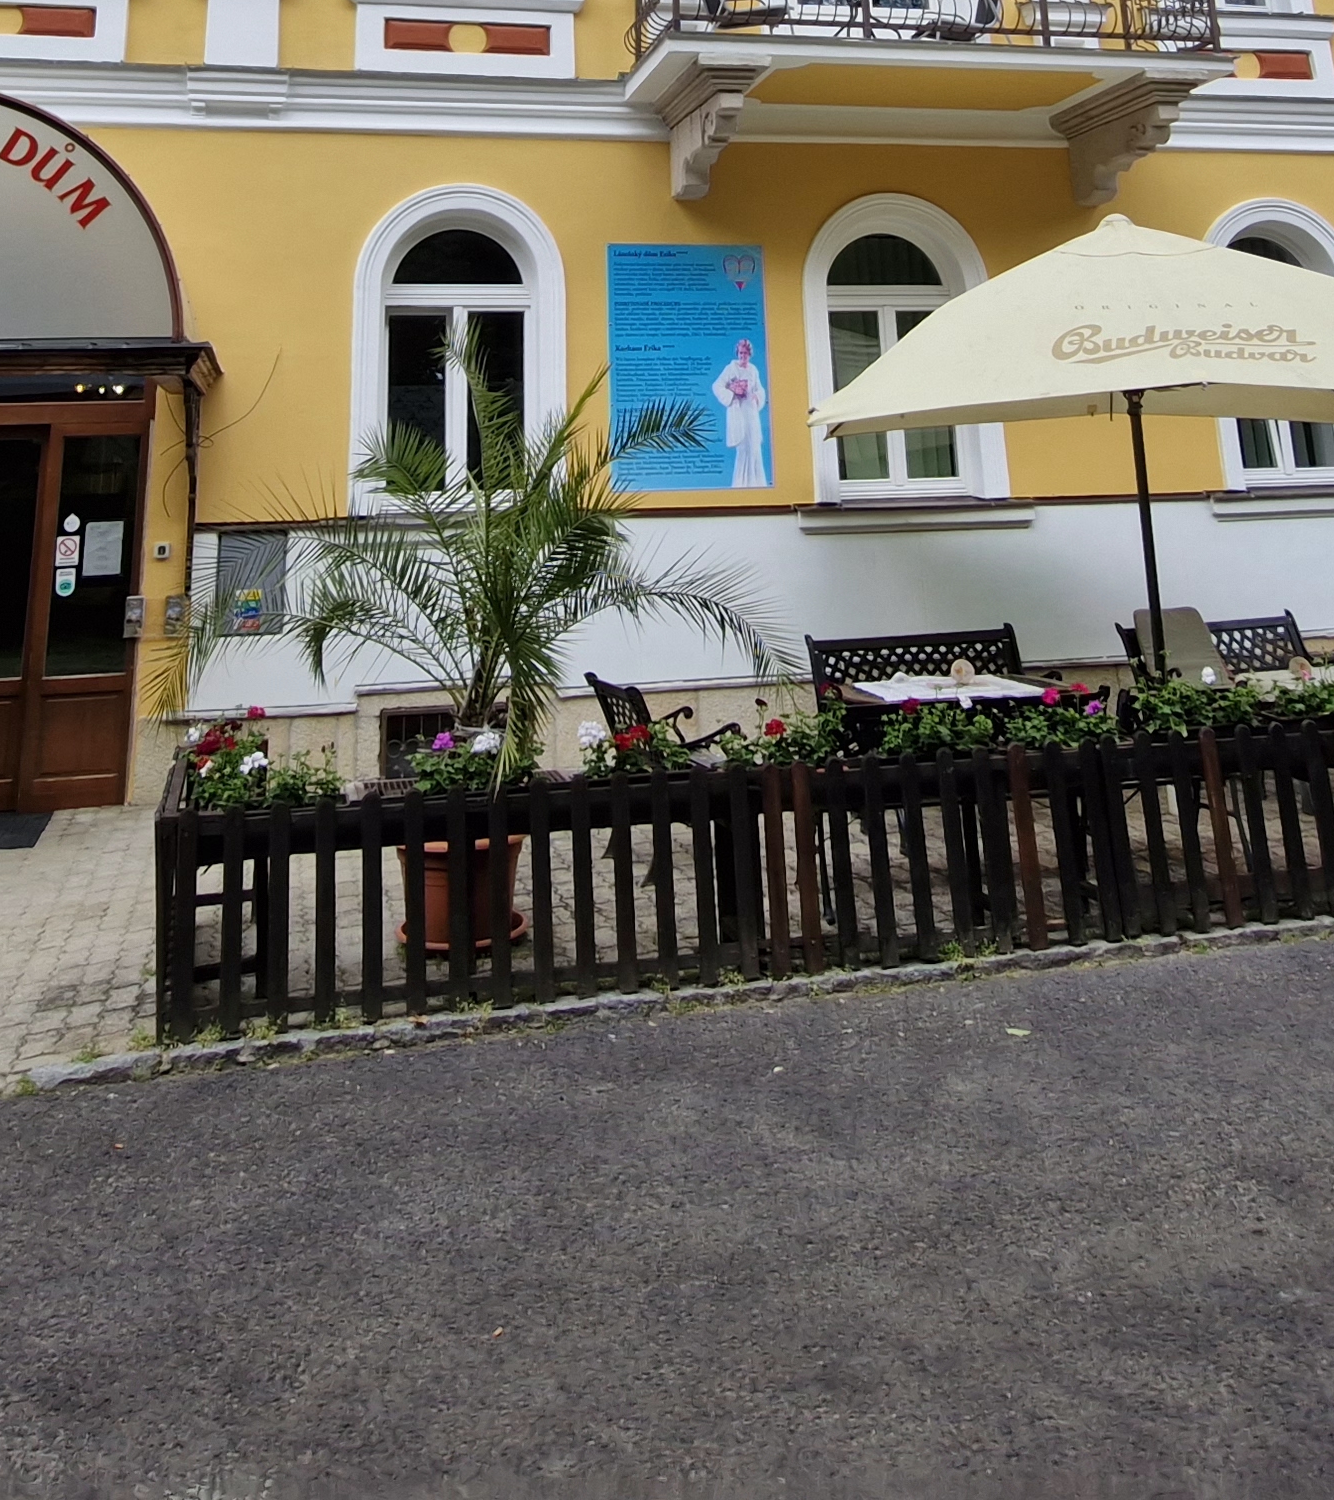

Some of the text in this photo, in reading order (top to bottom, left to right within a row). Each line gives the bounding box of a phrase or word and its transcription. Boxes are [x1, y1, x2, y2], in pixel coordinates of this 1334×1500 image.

[1073, 301, 1260, 311] ORIGINAL
[1051, 323, 1317, 364] Budweiser
[1168, 340, 1318, 364] Budvar
